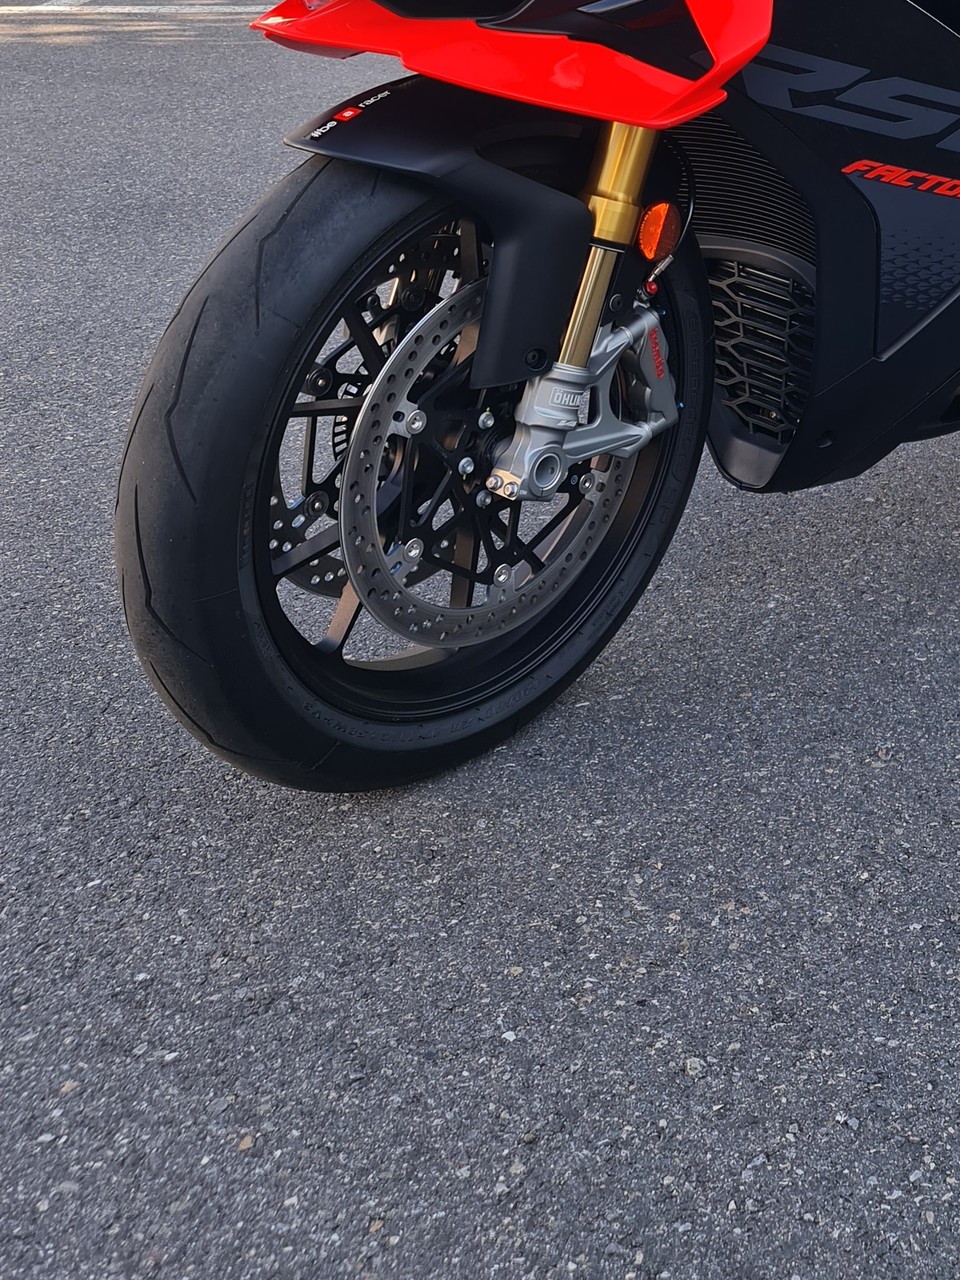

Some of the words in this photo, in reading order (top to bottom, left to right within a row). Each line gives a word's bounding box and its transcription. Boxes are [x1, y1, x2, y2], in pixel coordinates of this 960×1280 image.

[310, 120, 338, 138] #be
[357, 89, 391, 108] racer
[649, 326, 665, 380] brembo
